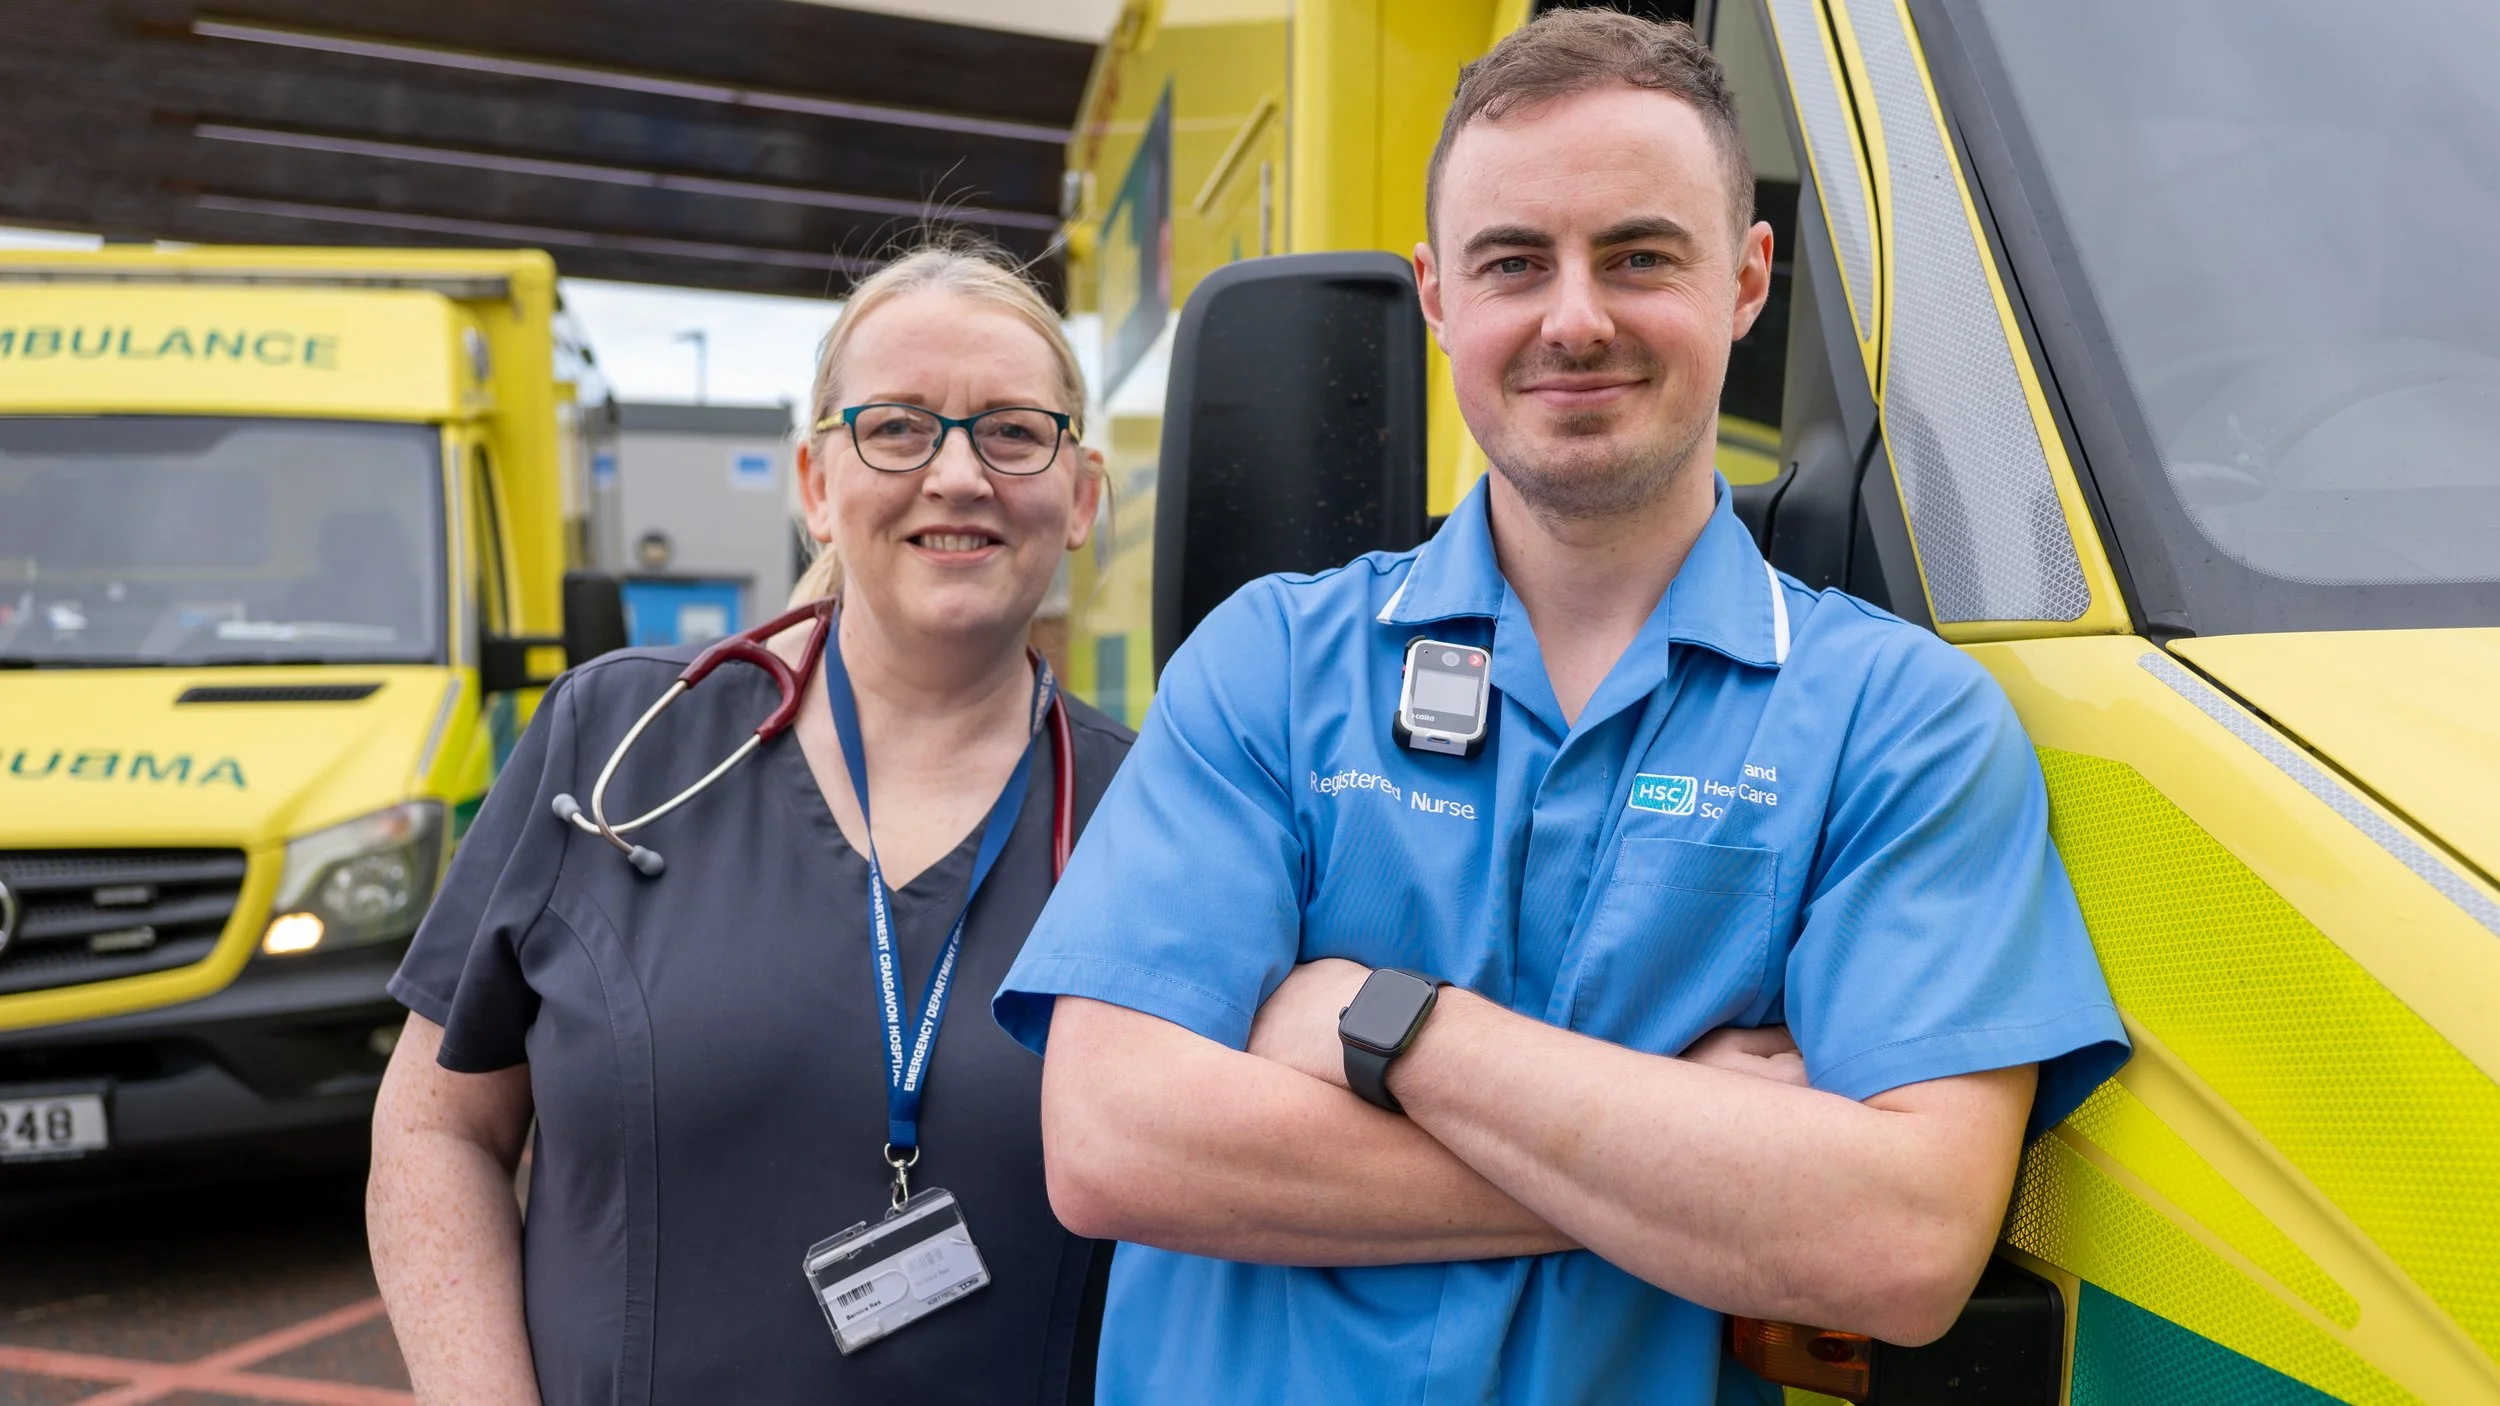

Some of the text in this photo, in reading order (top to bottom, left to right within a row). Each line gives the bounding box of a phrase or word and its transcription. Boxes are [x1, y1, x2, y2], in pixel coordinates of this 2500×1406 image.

[1744, 763, 1777, 782] and
[1411, 791, 1477, 820] Nurse
[1639, 785, 1682, 802] HSC
[1738, 784, 1777, 806] Care
[872, 874, 889, 951] DEPARTMENT
[879, 952, 899, 1023] CRAIGAVON
[903, 947, 957, 1092] EMERGENCY DEPARTMENT
